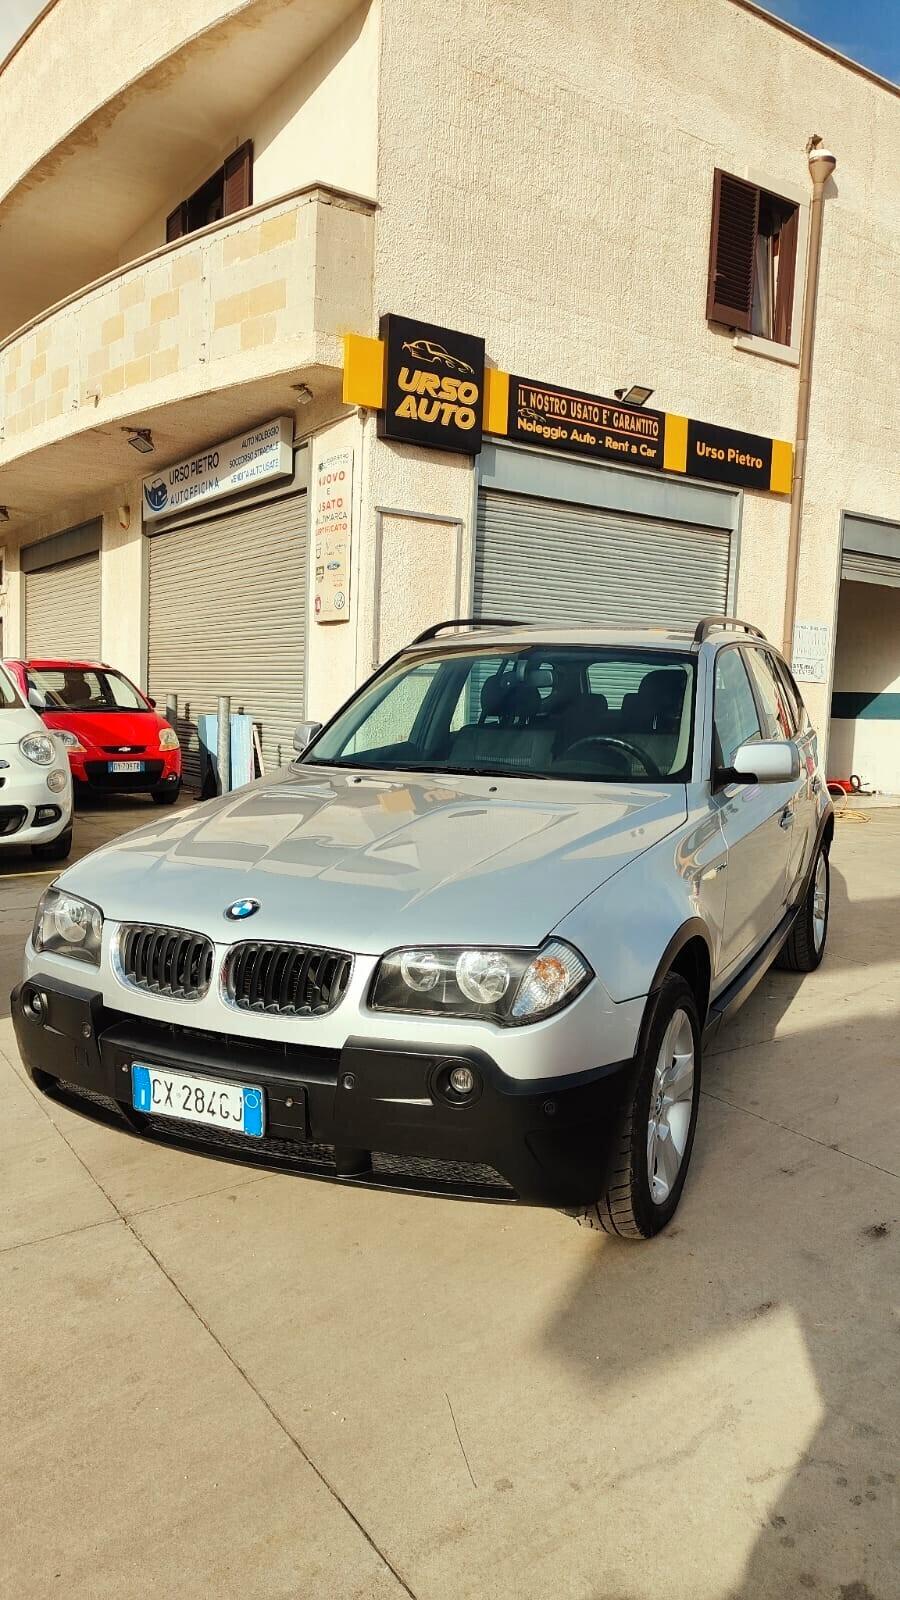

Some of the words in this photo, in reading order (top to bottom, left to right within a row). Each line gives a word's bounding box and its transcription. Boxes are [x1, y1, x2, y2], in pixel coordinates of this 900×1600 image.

[398, 367, 478, 404] URSO
[395, 395, 476, 430] AUTO
[518, 388, 527, 406] IL
[530, 393, 567, 415] NOSTRO
[570, 405, 599, 423] USATO
[613, 414, 659, 437] GARANTITO
[229, 451, 254, 469] SOCCORSO
[254, 440, 279, 459] STRADALE
[241, 434, 255, 449] AUTO
[254, 425, 280, 443] NOLEGGIO
[517, 417, 568, 440] Noleggio
[570, 429, 596, 445] Auto
[605, 436, 630, 452] Rent
[630, 444, 638, 454] a
[640, 444, 657, 458] Car
[169, 464, 190, 486] URSO
[190, 451, 220, 478] PIETRO
[696, 441, 725, 460] Urso
[727, 448, 763, 469] Pietro
[170, 477, 220, 506] AUTOFFICINA
[152, 1078, 173, 1108] CX
[181, 1084, 243, 1122] 284GJ
